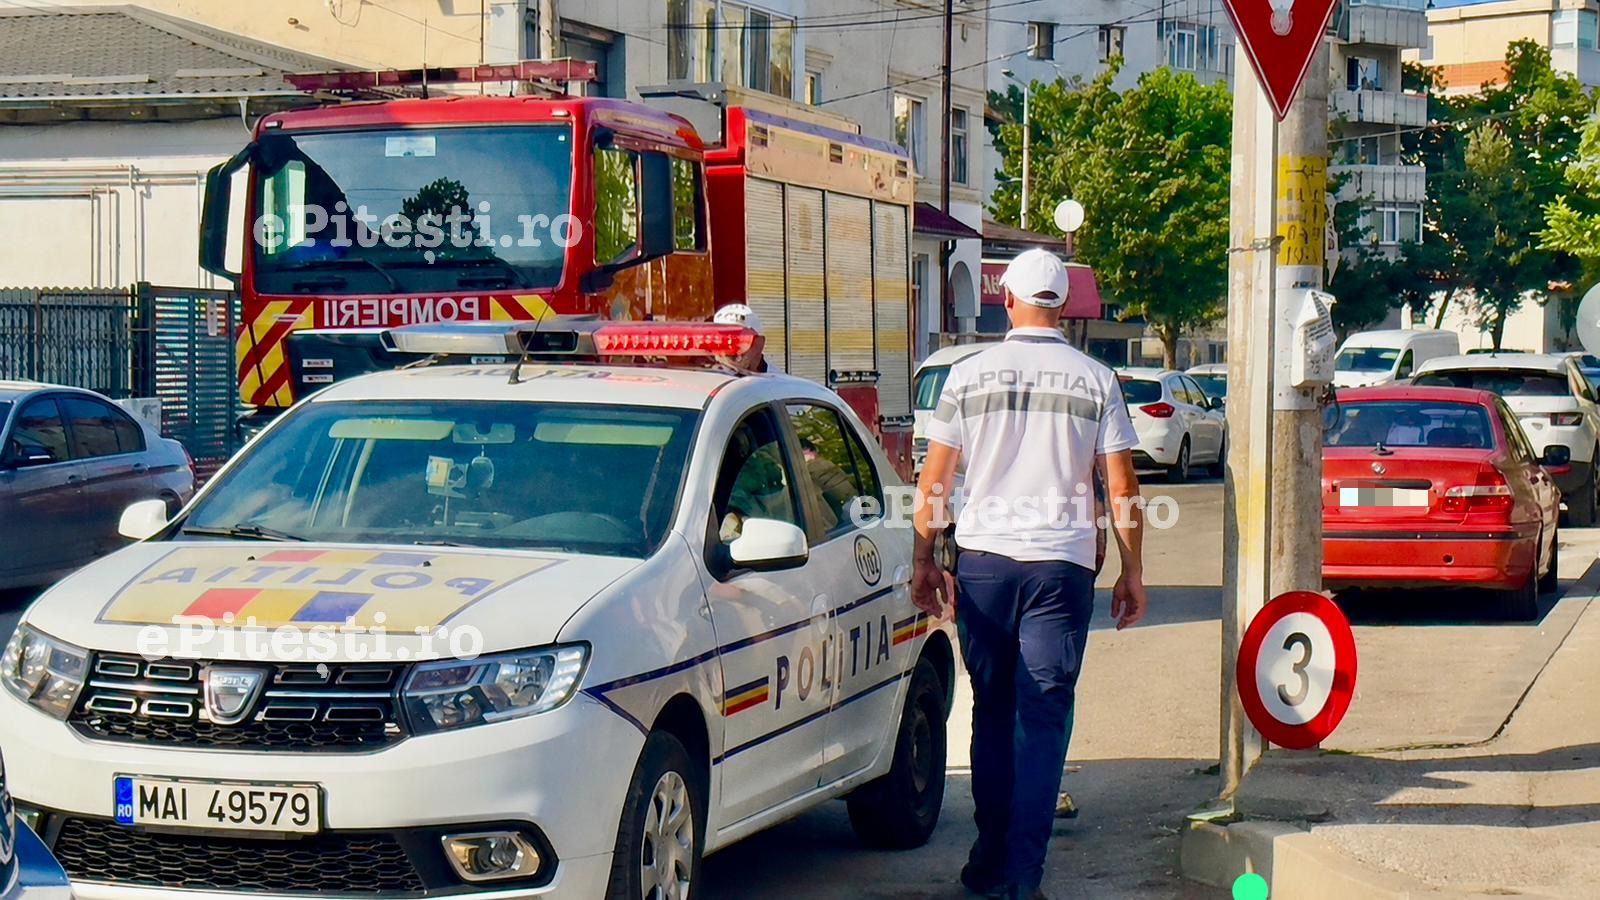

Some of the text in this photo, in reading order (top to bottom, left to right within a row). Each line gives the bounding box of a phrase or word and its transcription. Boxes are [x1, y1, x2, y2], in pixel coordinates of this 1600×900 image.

[979, 369, 1089, 394] POLITIA
[774, 614, 890, 711] POLITIA
[1277, 632, 1312, 707] 3
[117, 804, 132, 818] RO
[139, 785, 310, 826] MAI 49579
